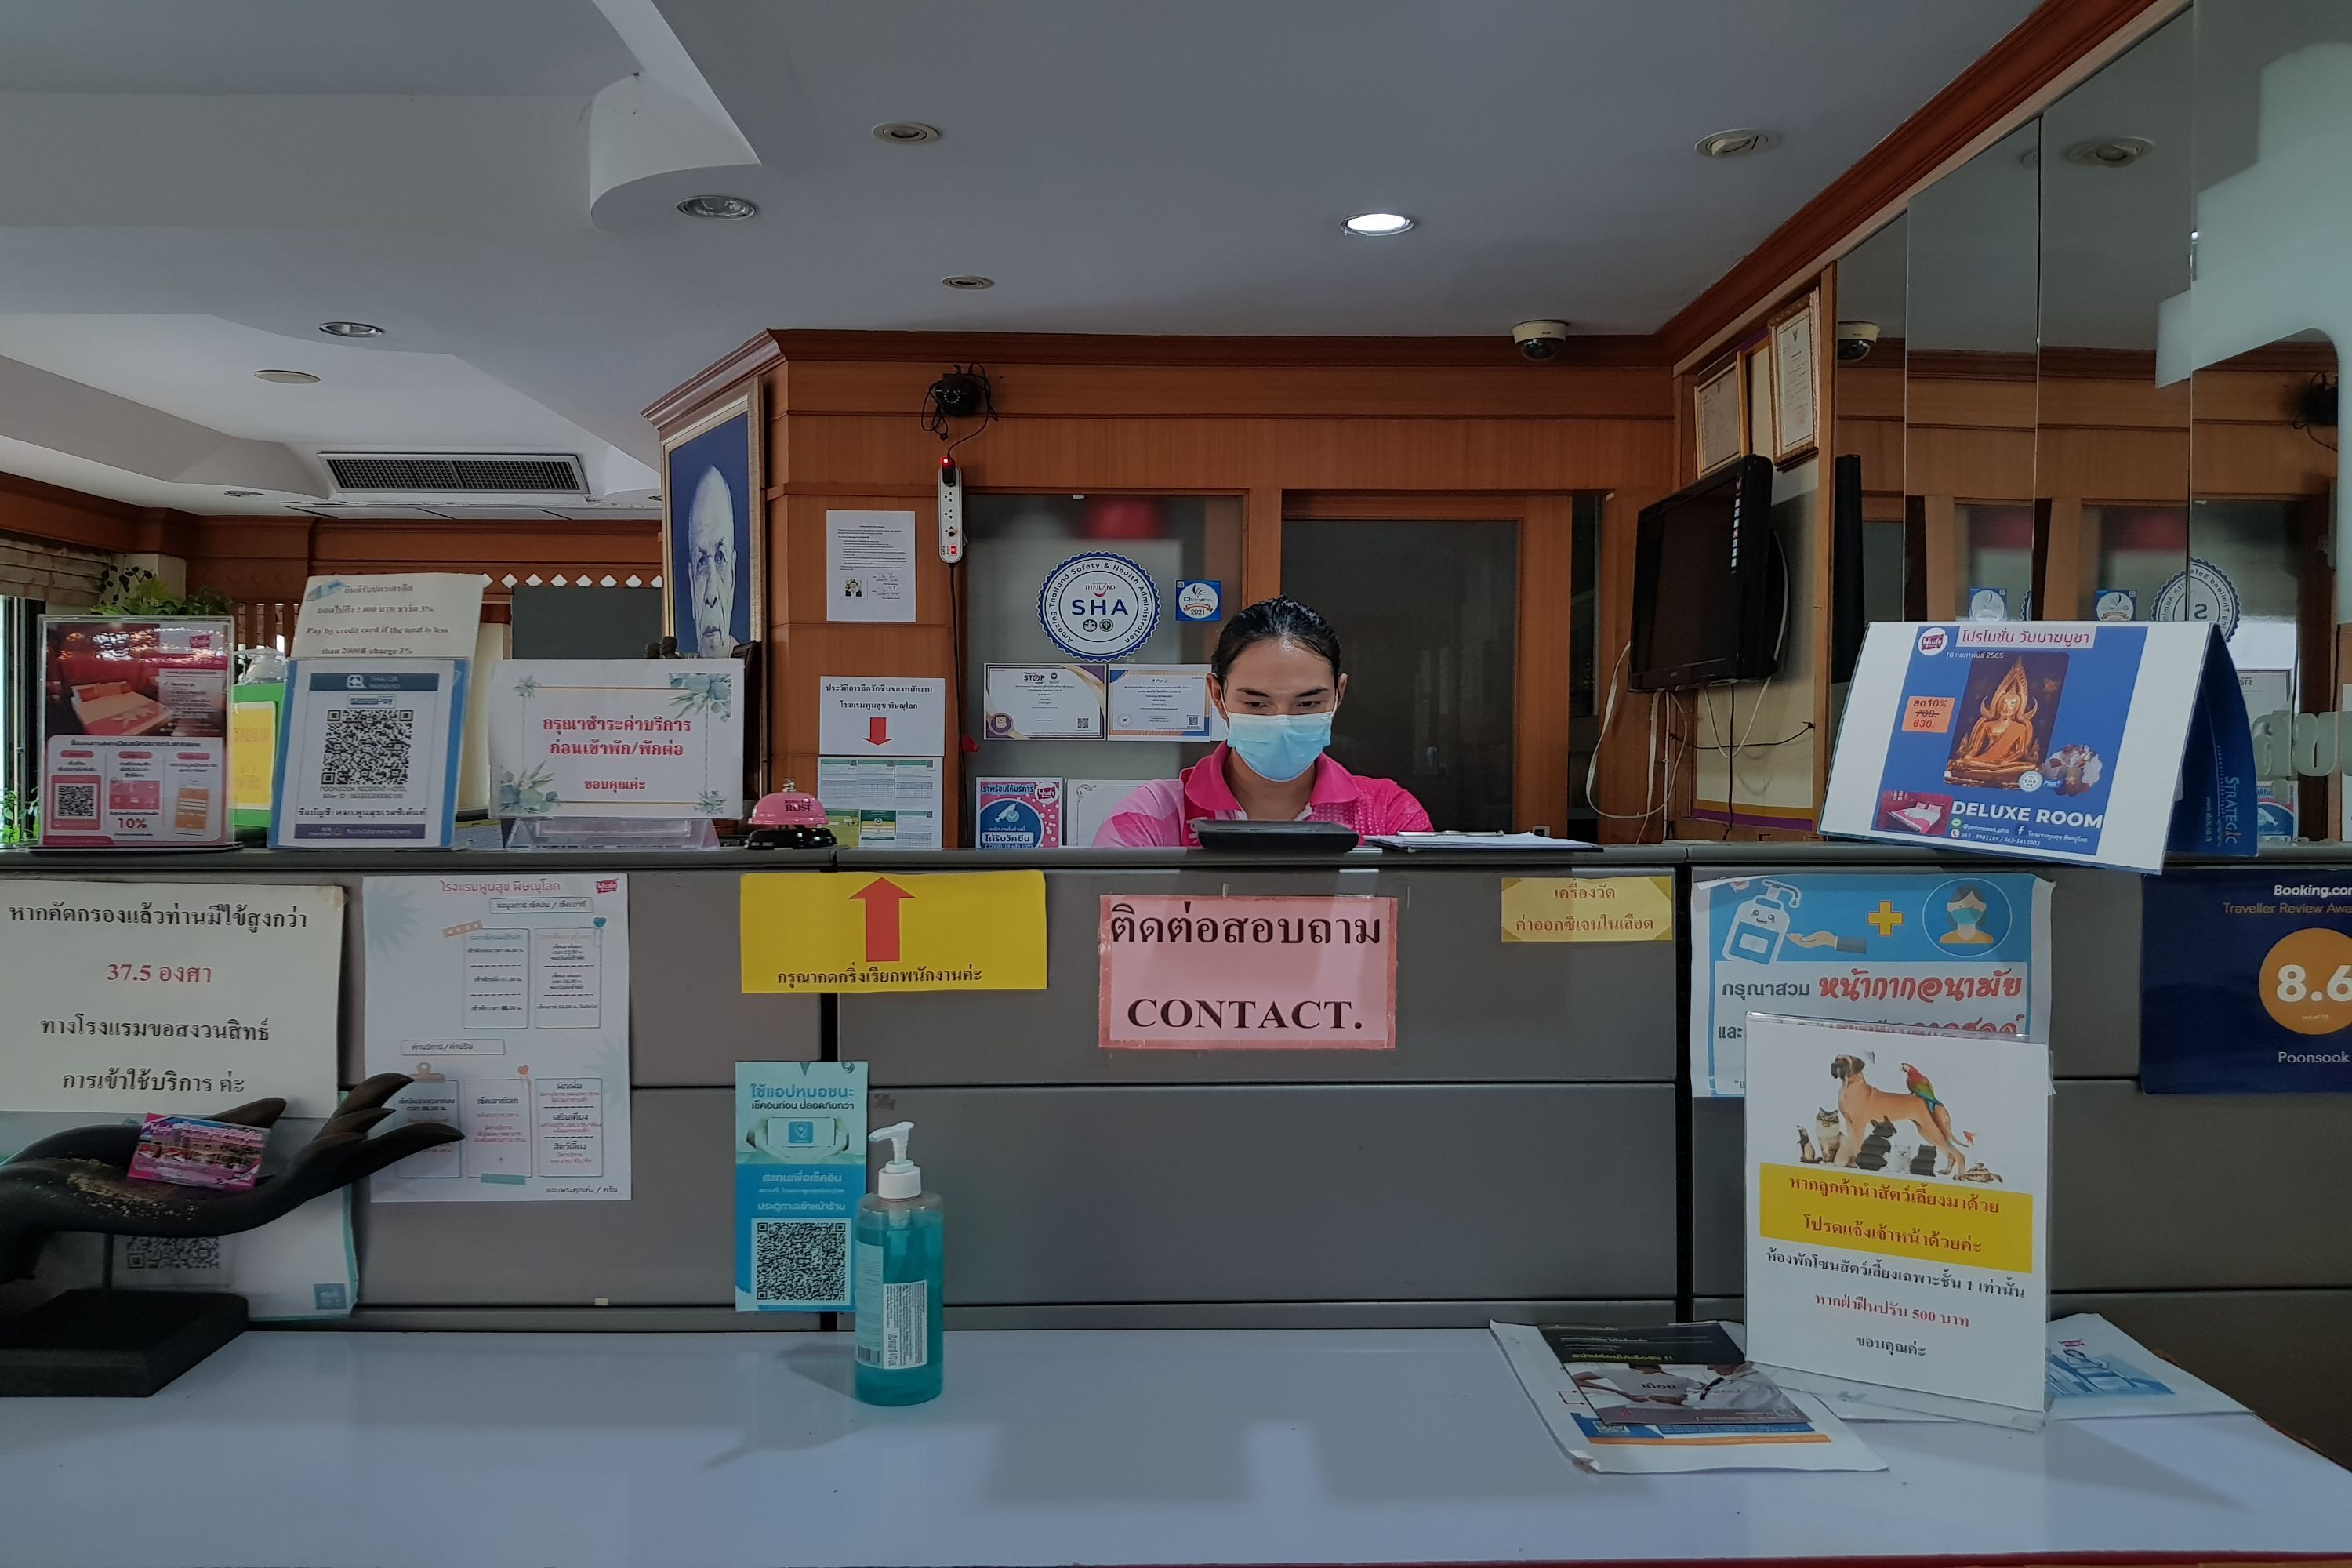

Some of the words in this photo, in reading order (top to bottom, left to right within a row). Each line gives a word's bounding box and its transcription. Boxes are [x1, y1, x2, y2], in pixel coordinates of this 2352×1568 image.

[1070, 562, 1101, 575] Safety
[1112, 564, 1139, 585] Health
[1048, 573, 1069, 608] Thailand
[1071, 598, 1129, 615] SHA
[1124, 586, 1150, 644] Administration
[1051, 611, 1074, 643] Amazing
[1962, 627, 2014, 643] โปรโมชั่น
[2020, 630, 2090, 648] วันมาฆบูชา
[543, 715, 691, 735] กรุณาชำระค่าบริการ
[550, 738, 684, 756] ก่อนเข้าพัก/พักต่อ
[584, 776, 646, 793] ขอบคุณค่ะ
[785, 804, 814, 812] ROSE
[1951, 800, 2032, 822] DELUXE
[2035, 808, 2103, 829] ROOM
[118, 818, 147, 829] 10%
[985, 833, 1030, 842] ได้รับวัคซีน
[439, 879, 510, 895] โรงแรมพูนสุข
[514, 877, 561, 895] พิษณุโลก
[1554, 879, 1616, 899] เครื่องวัด
[9, 901, 307, 933] หากคัดกรองแล้วท่านมีไข้สูงกว่า
[2222, 902, 2277, 914] Traveller
[2279, 902, 2323, 914] Review
[1110, 901, 1381, 945] ติดต่อสอบถาม
[1515, 913, 1654, 931] ค่าออกซิเจนในเลือด
[107, 963, 152, 983] 37.5
[159, 964, 212, 984] องศา
[2276, 964, 2352, 1003] 8.6
[1722, 981, 1810, 1001] กรุณาสวม
[1819, 967, 2023, 1003] หน้ากากอนามัย
[1127, 998, 1363, 1030] CONTACT.
[40, 1013, 270, 1041] ทางโรงแรมขอสงวนสิทธิ์
[2278, 1051, 2350, 1064] Poonsook
[62, 1067, 212, 1093] การเข้าใช้บริการ
[219, 1071, 245, 1094] ค่ะ
[750, 1083, 854, 1098] ใช้แอปหมอชนะ
[751, 1099, 797, 1109] เช็คอินก่อน
[799, 1098, 855, 1109] ปลอดภัยกว่า
[1788, 1175, 2000, 1214] หากลูกค้านำสัตว์เลี้ยงมาด้วย
[1802, 1213, 1982, 1254] โปรดแจ้งเจ้าหน้าด้วยค่ะ
[1766, 1246, 1962, 1290] ห้องพักโซนสัตว์เลี้ยงเฉพาะชั้น
[1967, 1280, 1973, 1290] 1
[1978, 1276, 2026, 1298] เท่านั้น
[1815, 1292, 1907, 1319] หากฝ่าฝืนปรับ
[1911, 1308, 1936, 1323] 500
[1941, 1313, 1969, 1328] บาท
[1856, 1334, 1926, 1358] ขอบคุณค่ะ
